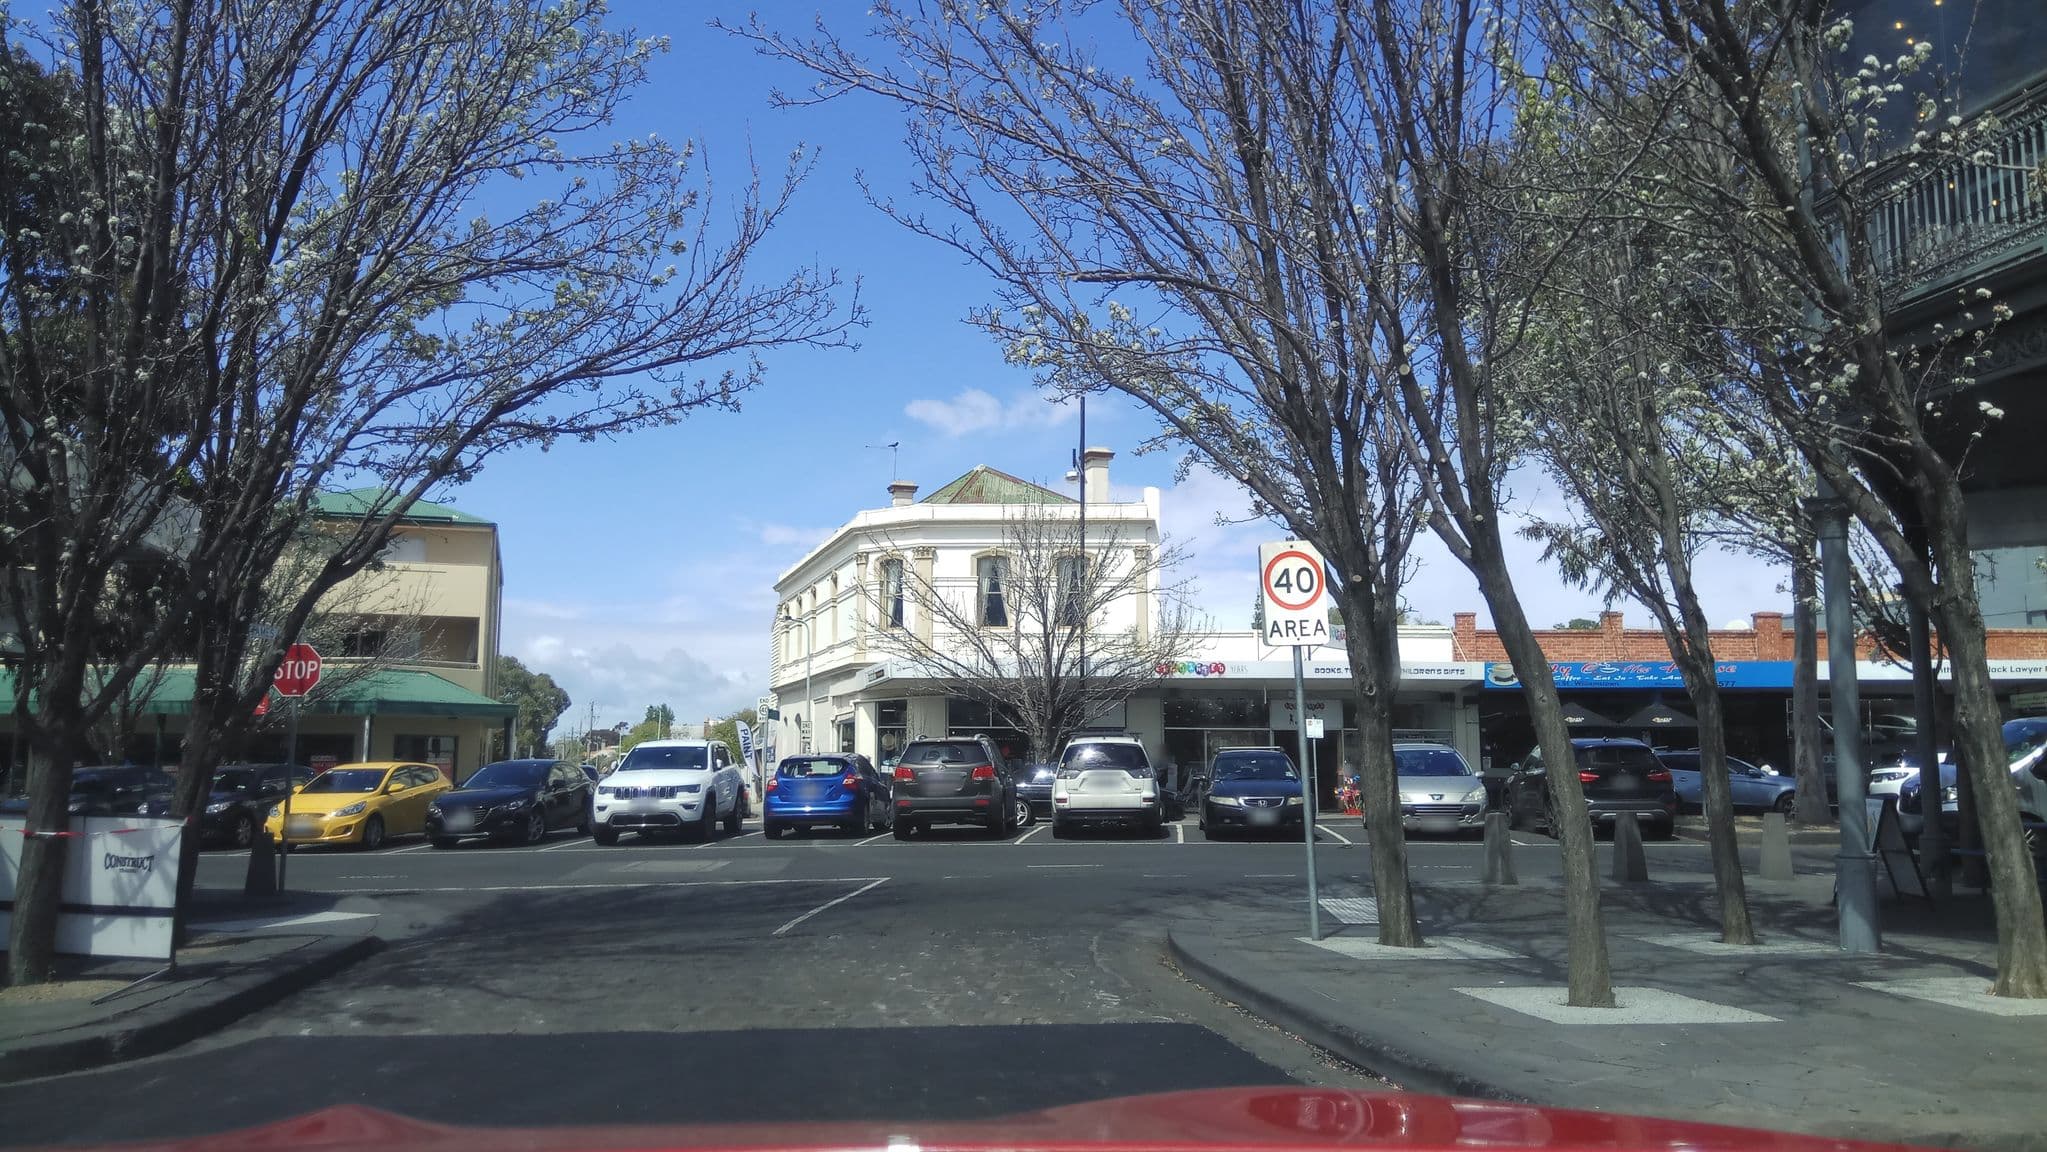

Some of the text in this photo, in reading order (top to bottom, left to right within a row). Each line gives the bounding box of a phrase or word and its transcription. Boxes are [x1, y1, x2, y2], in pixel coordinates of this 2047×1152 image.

[1274, 566, 1315, 594] 40
[1269, 619, 1327, 638] AREA
[274, 660, 319, 680] STOP
[2010, 665, 2042, 674] Lawyer
[741, 728, 753, 760] PAINT
[104, 852, 155, 872] CONSTRUCT
